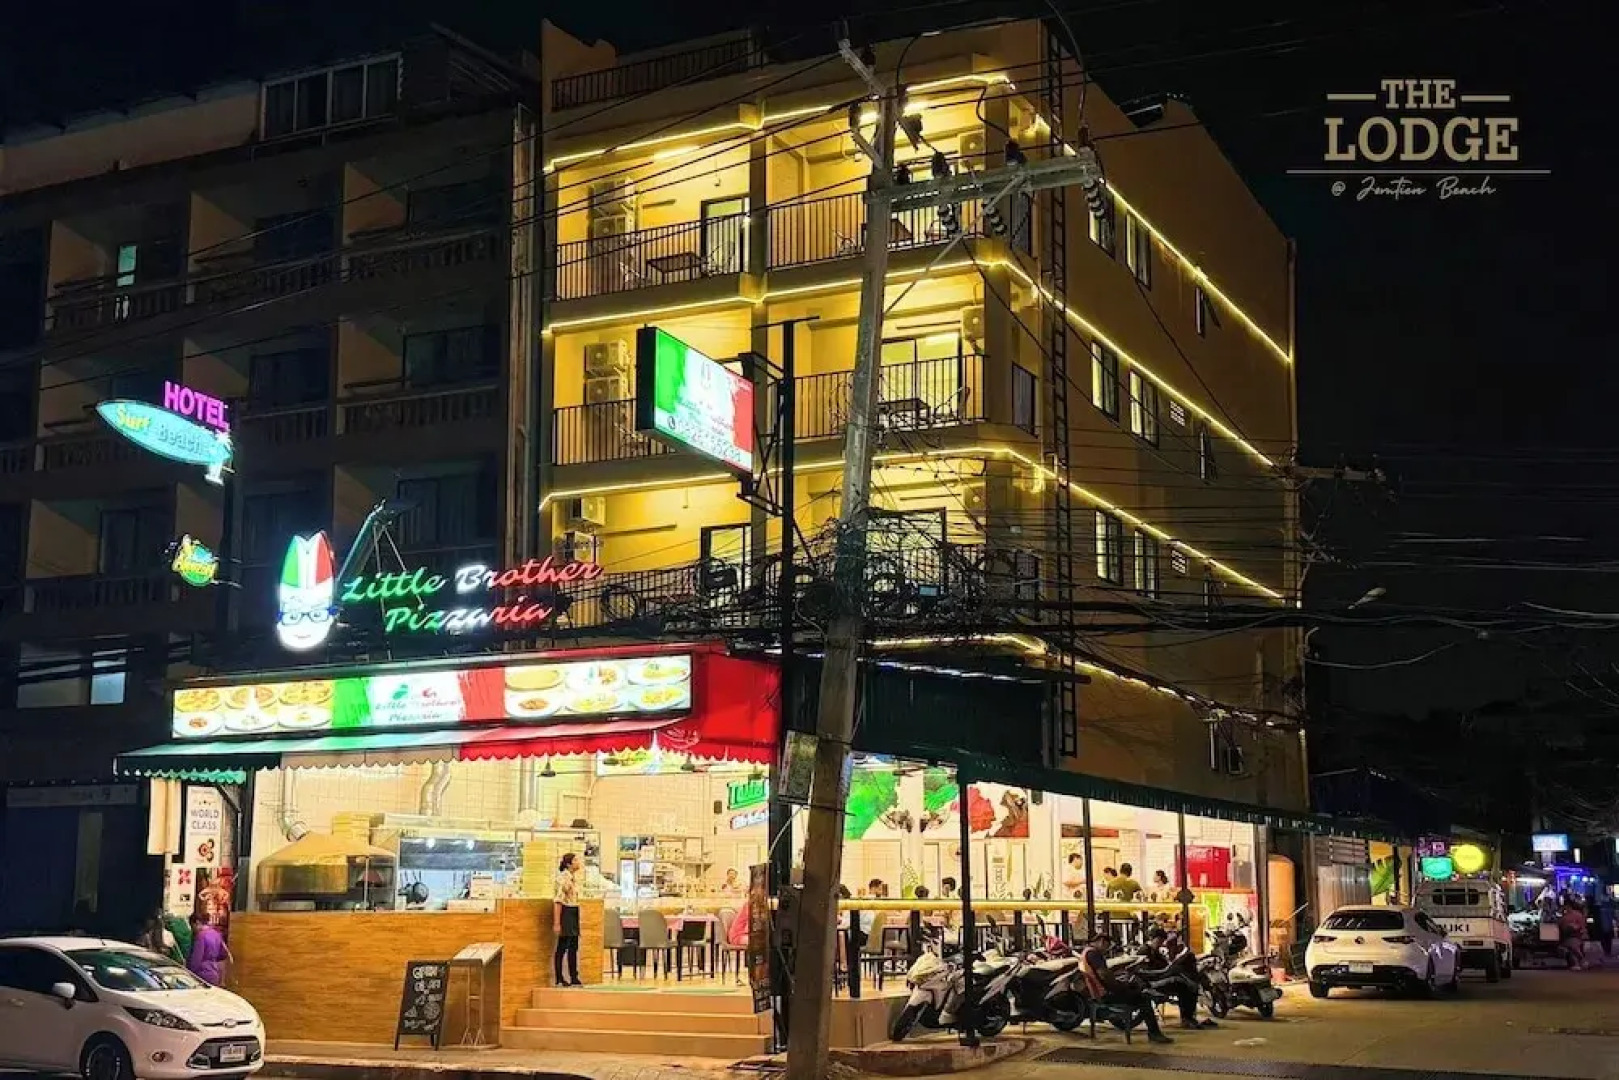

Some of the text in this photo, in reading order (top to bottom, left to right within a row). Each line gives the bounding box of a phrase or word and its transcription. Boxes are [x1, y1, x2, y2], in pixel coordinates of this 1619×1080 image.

[116, 403, 151, 431] Surf
[164, 380, 230, 432] HOTEL
[341, 555, 603, 602] Little Brother
[385, 595, 552, 634] Pizzaria
[191, 809, 219, 818] WORLD
[192, 820, 217, 829] CLASS
